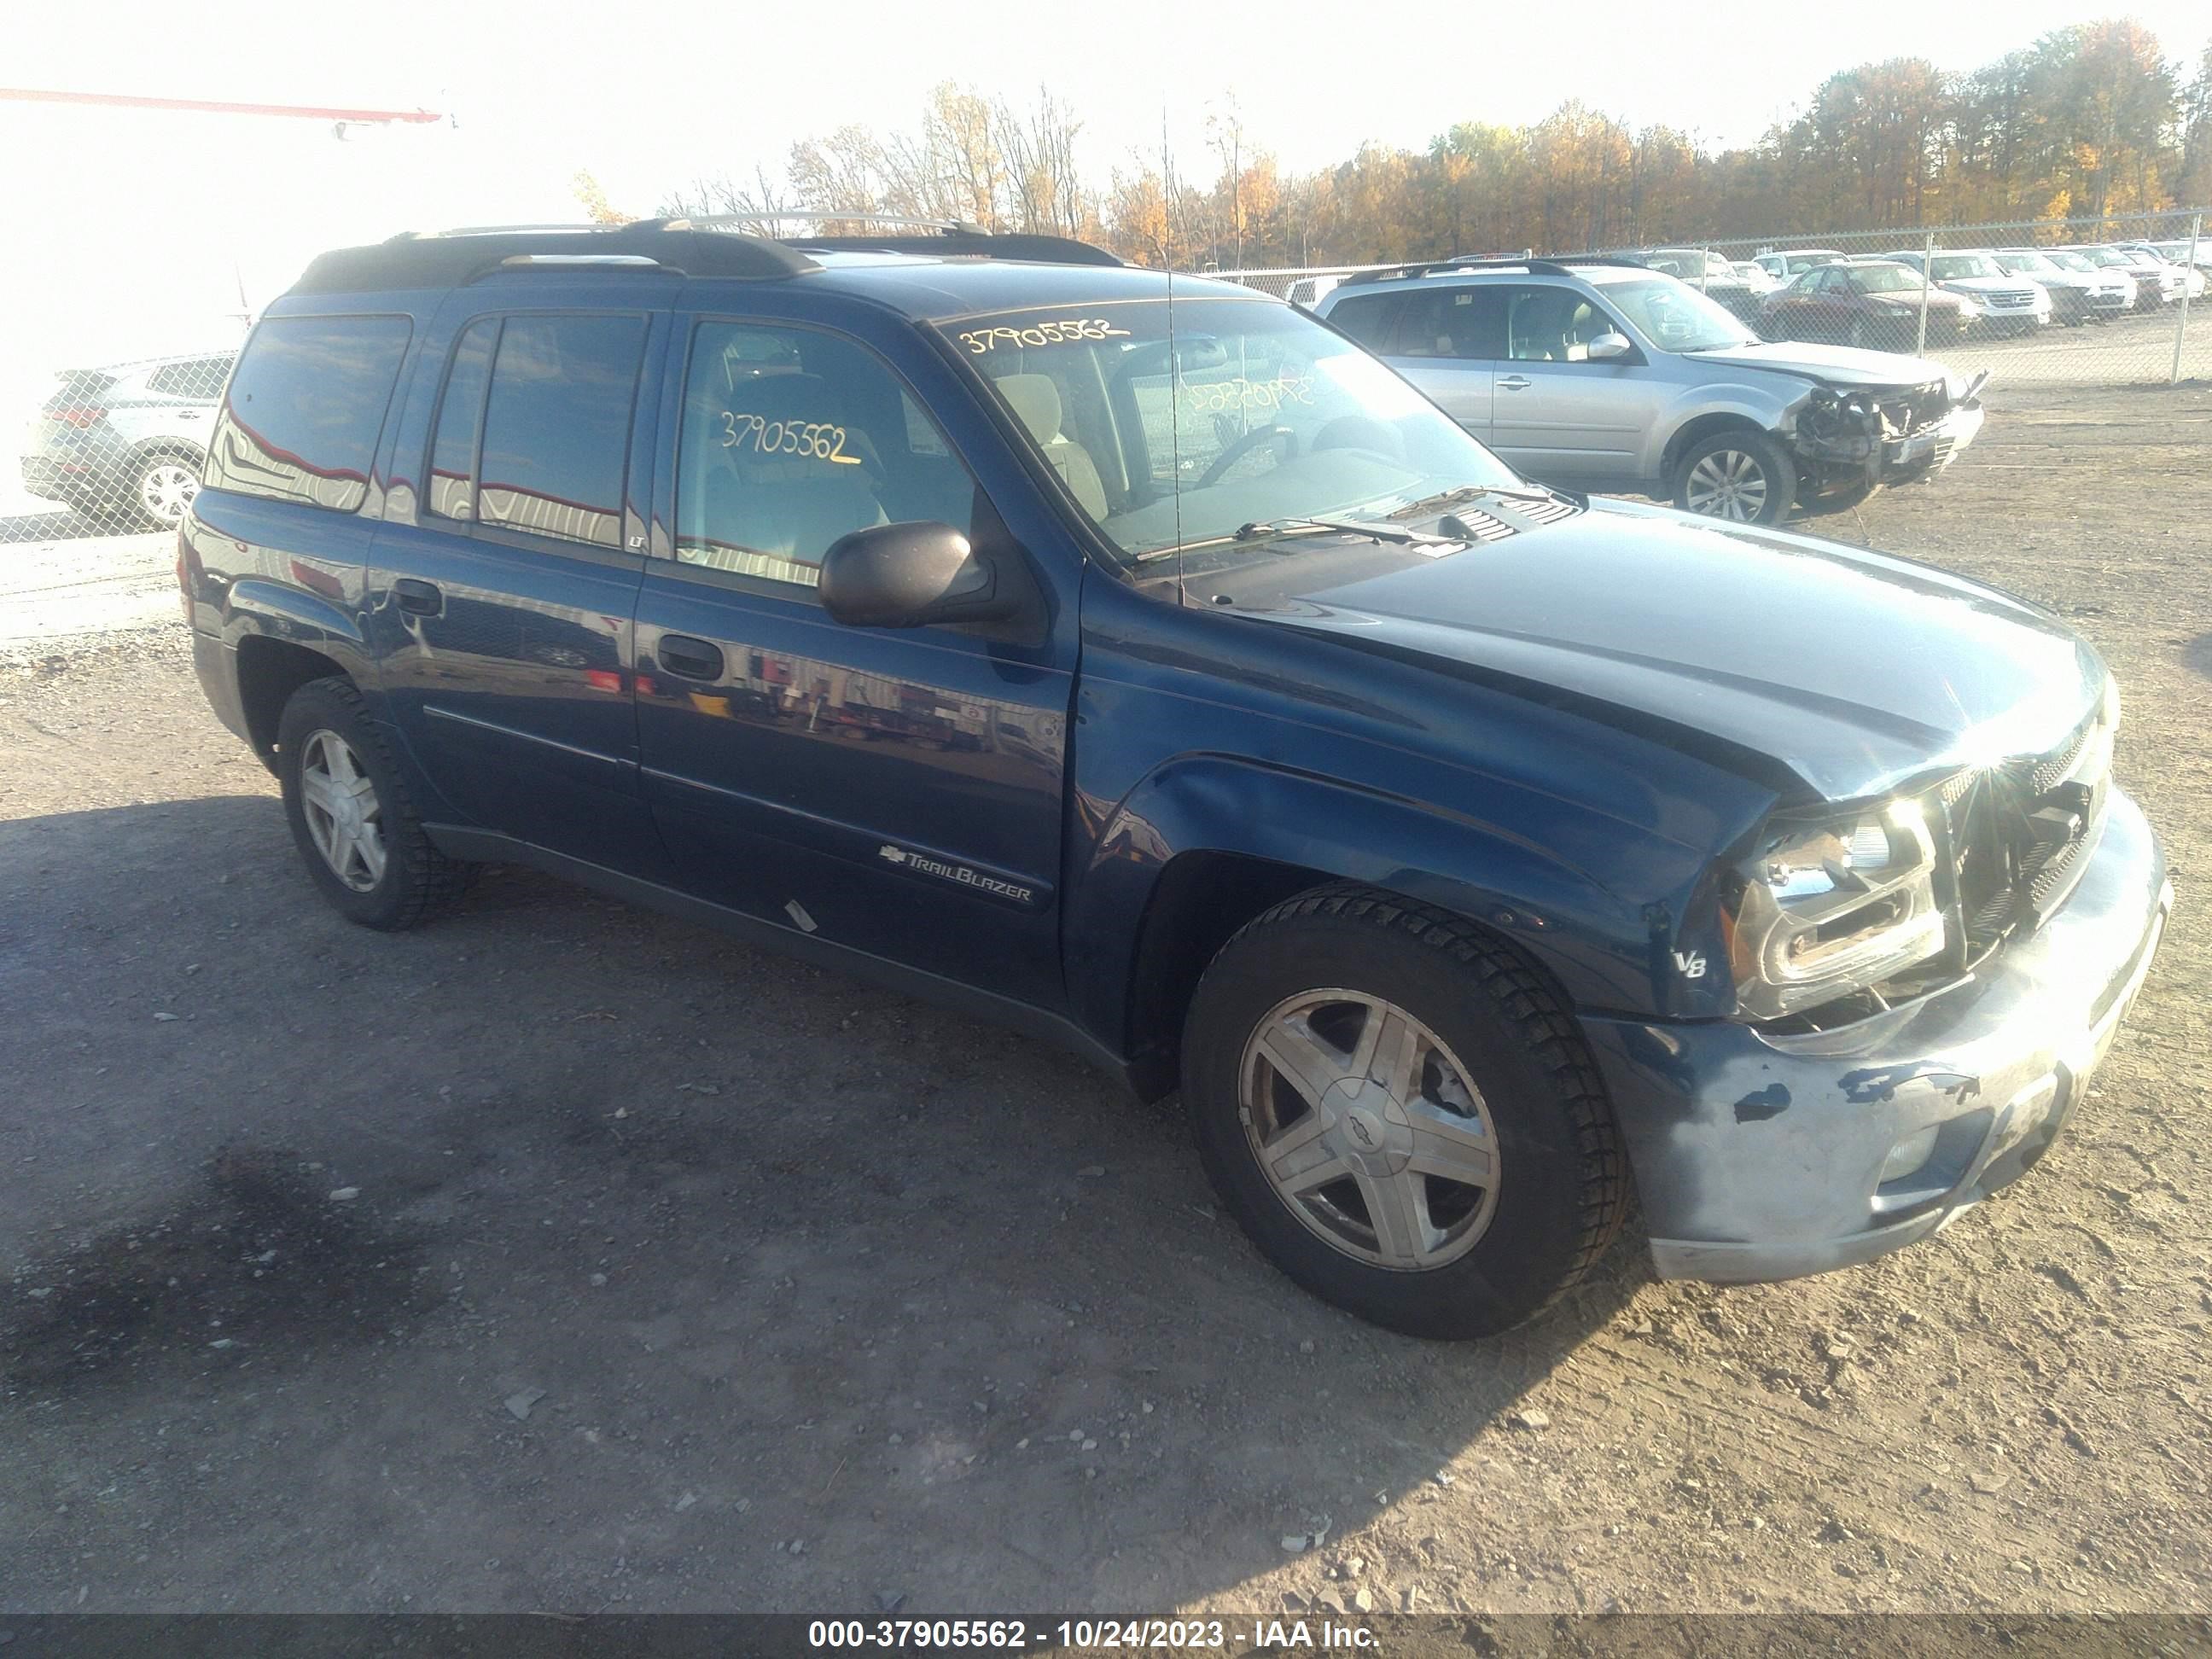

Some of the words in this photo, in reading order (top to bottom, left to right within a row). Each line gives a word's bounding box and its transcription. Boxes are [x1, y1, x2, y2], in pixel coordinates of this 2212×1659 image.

[959, 319, 1131, 353] 37905562
[721, 410, 862, 464] 37905562
[629, 536, 645, 548] LT
[1673, 950, 1707, 978] V8
